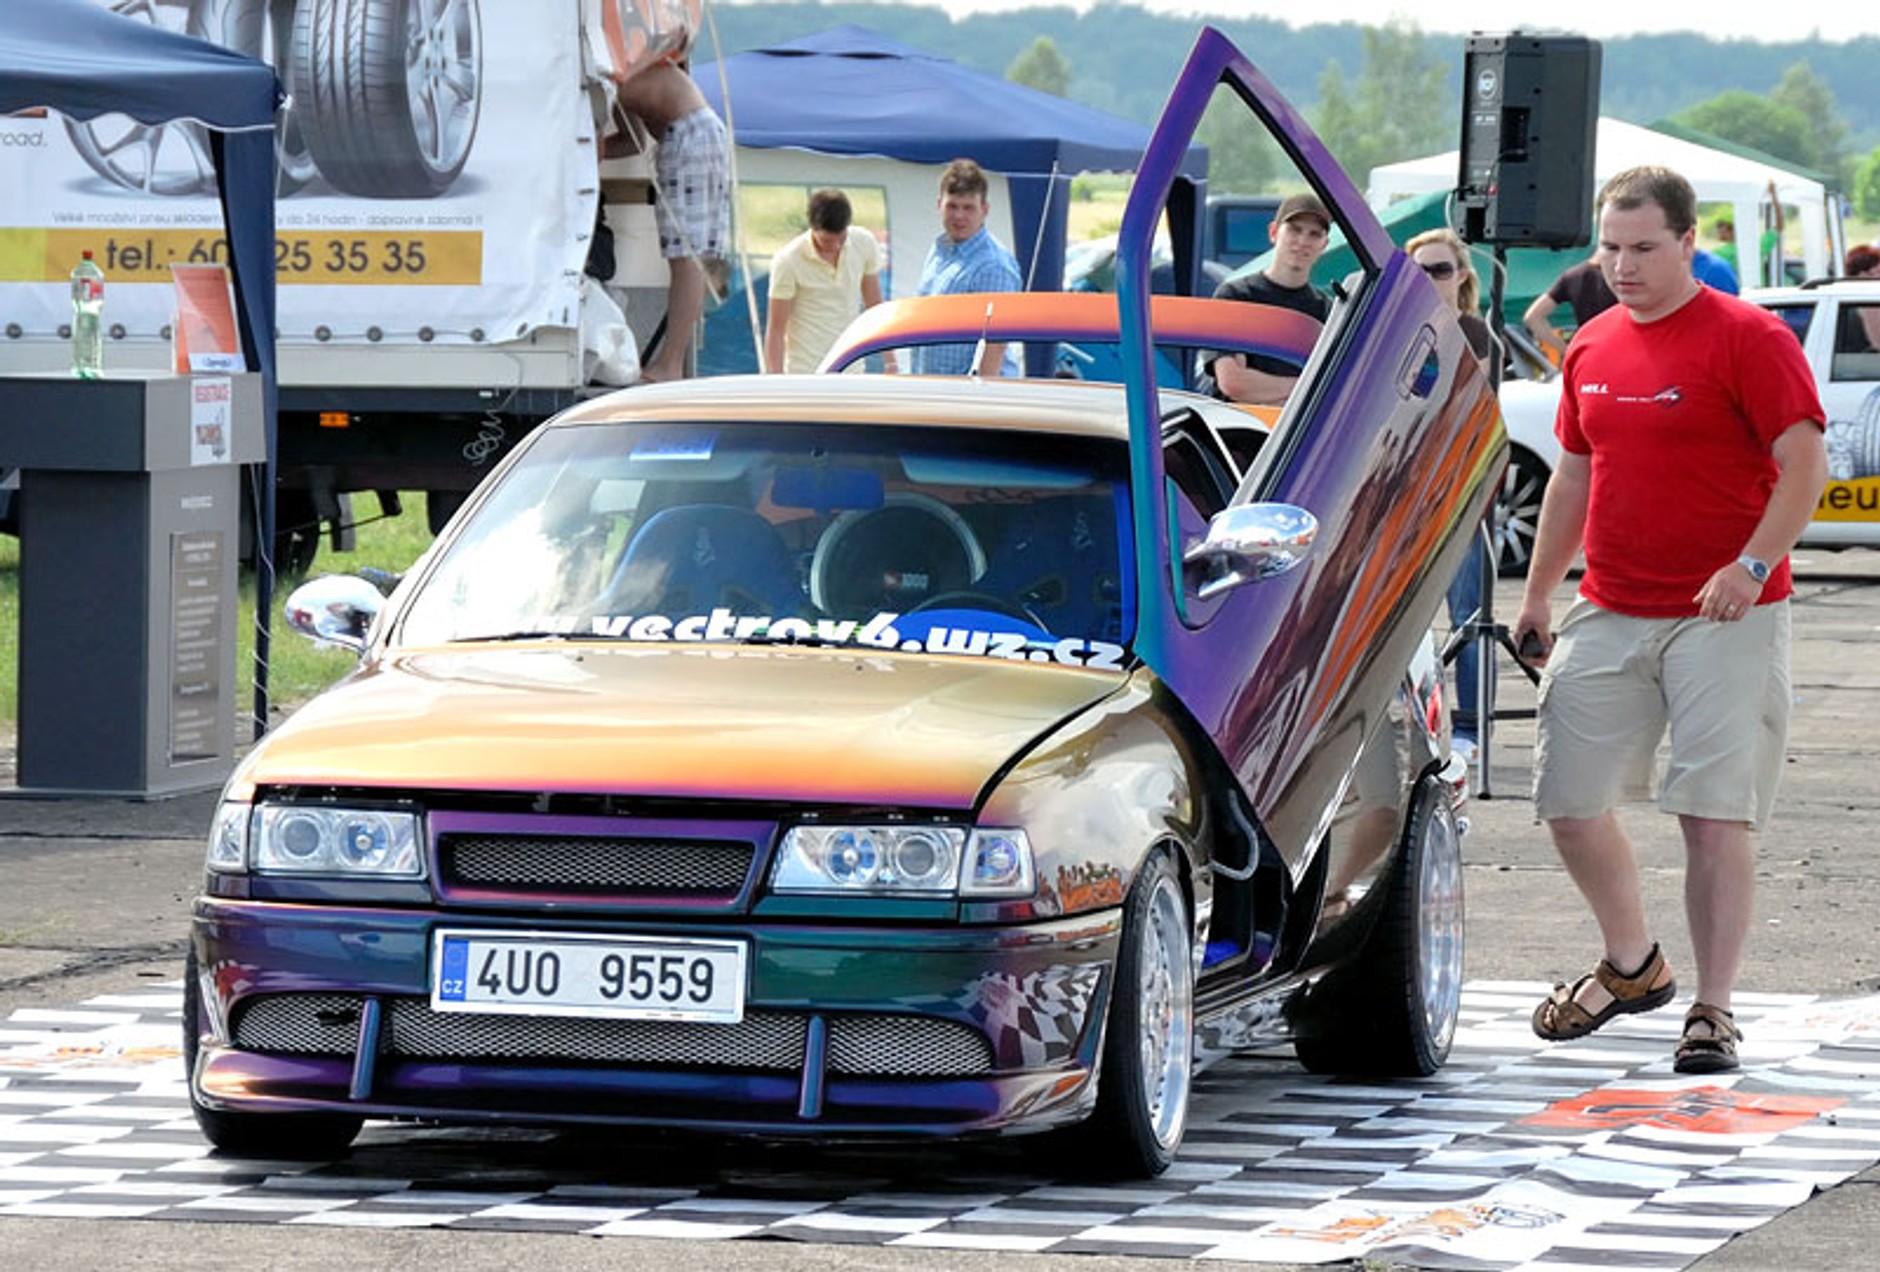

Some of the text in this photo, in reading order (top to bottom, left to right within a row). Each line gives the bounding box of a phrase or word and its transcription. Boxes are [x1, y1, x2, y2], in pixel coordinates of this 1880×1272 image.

[0, 130, 47, 147] oad.
[274, 240, 312, 272] 25
[325, 240, 369, 273] 35
[381, 240, 426, 273] 35
[441, 980, 463, 994] CZ
[477, 948, 714, 1003] 4U0 9559
